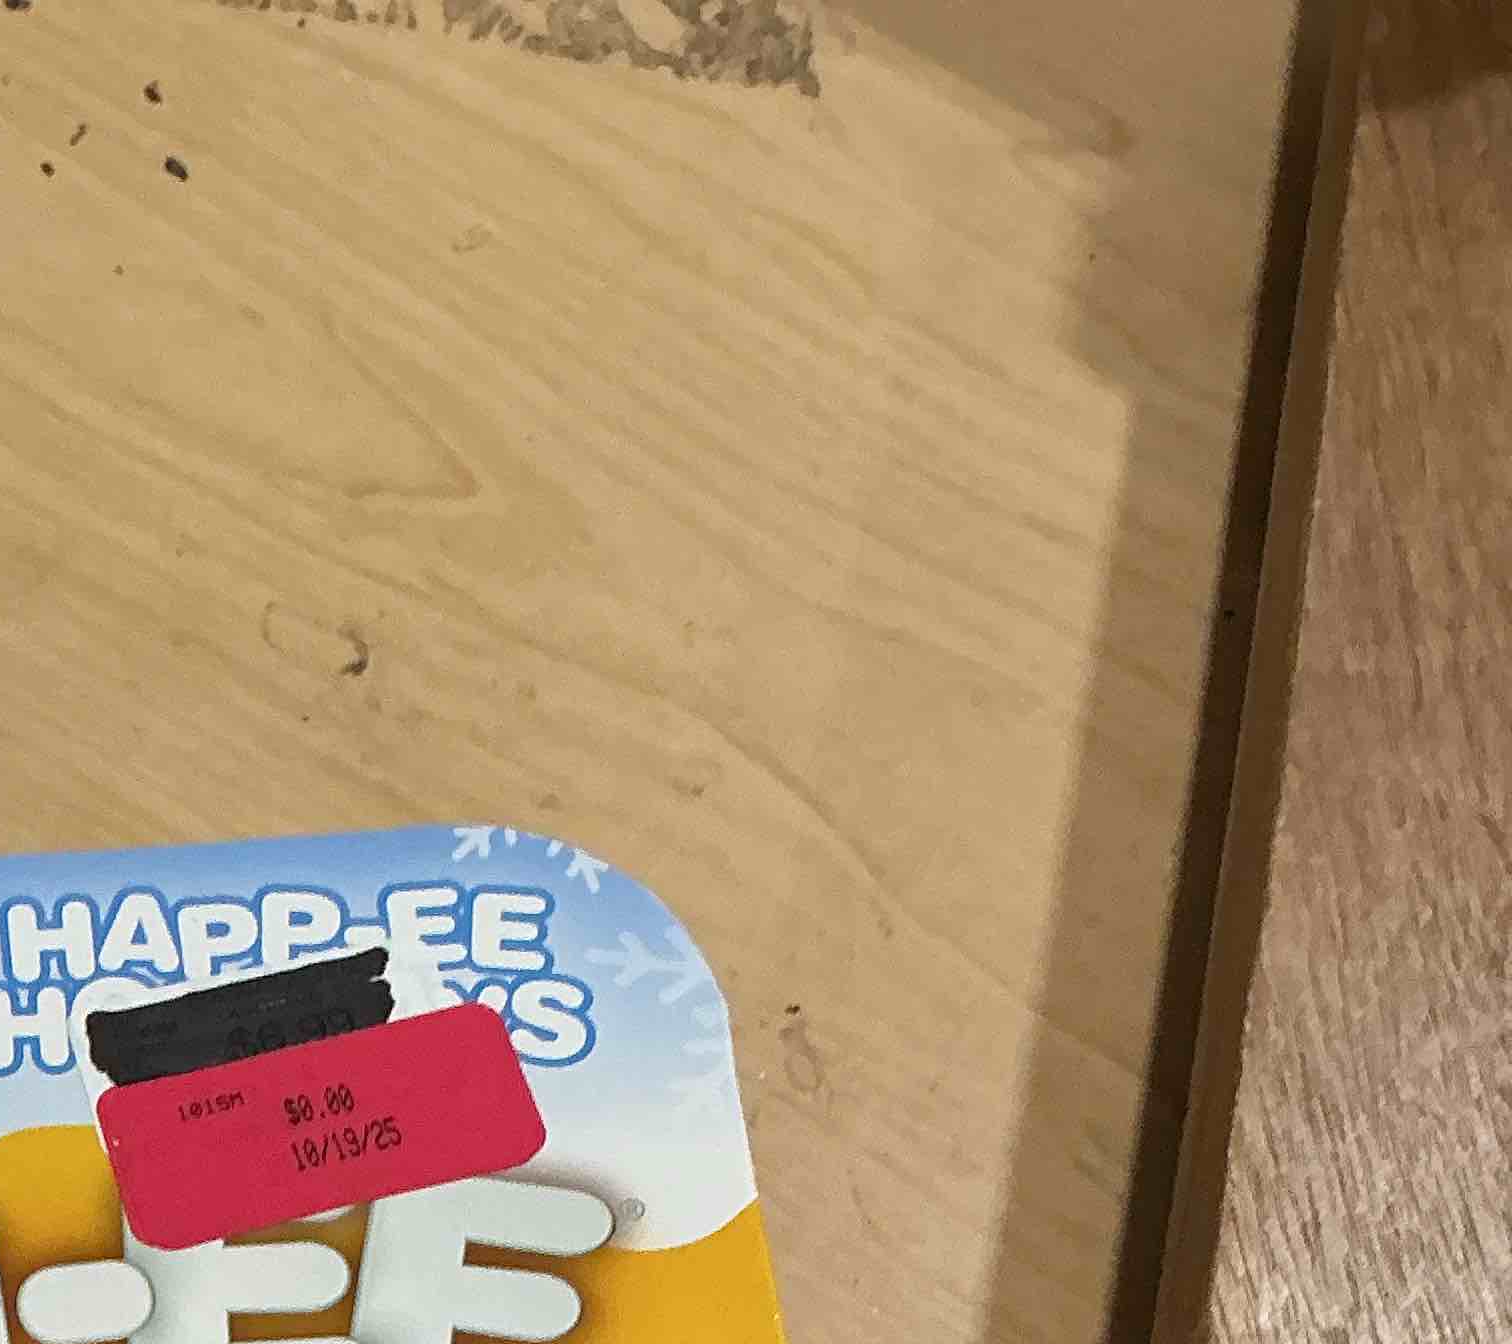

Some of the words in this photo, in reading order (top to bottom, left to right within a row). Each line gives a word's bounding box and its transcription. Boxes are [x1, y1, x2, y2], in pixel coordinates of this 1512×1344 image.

[5, 888, 546, 982] HAPP-EE
[284, 1083, 355, 1126] $0.00
[292, 1116, 402, 1172] 10/19/25
